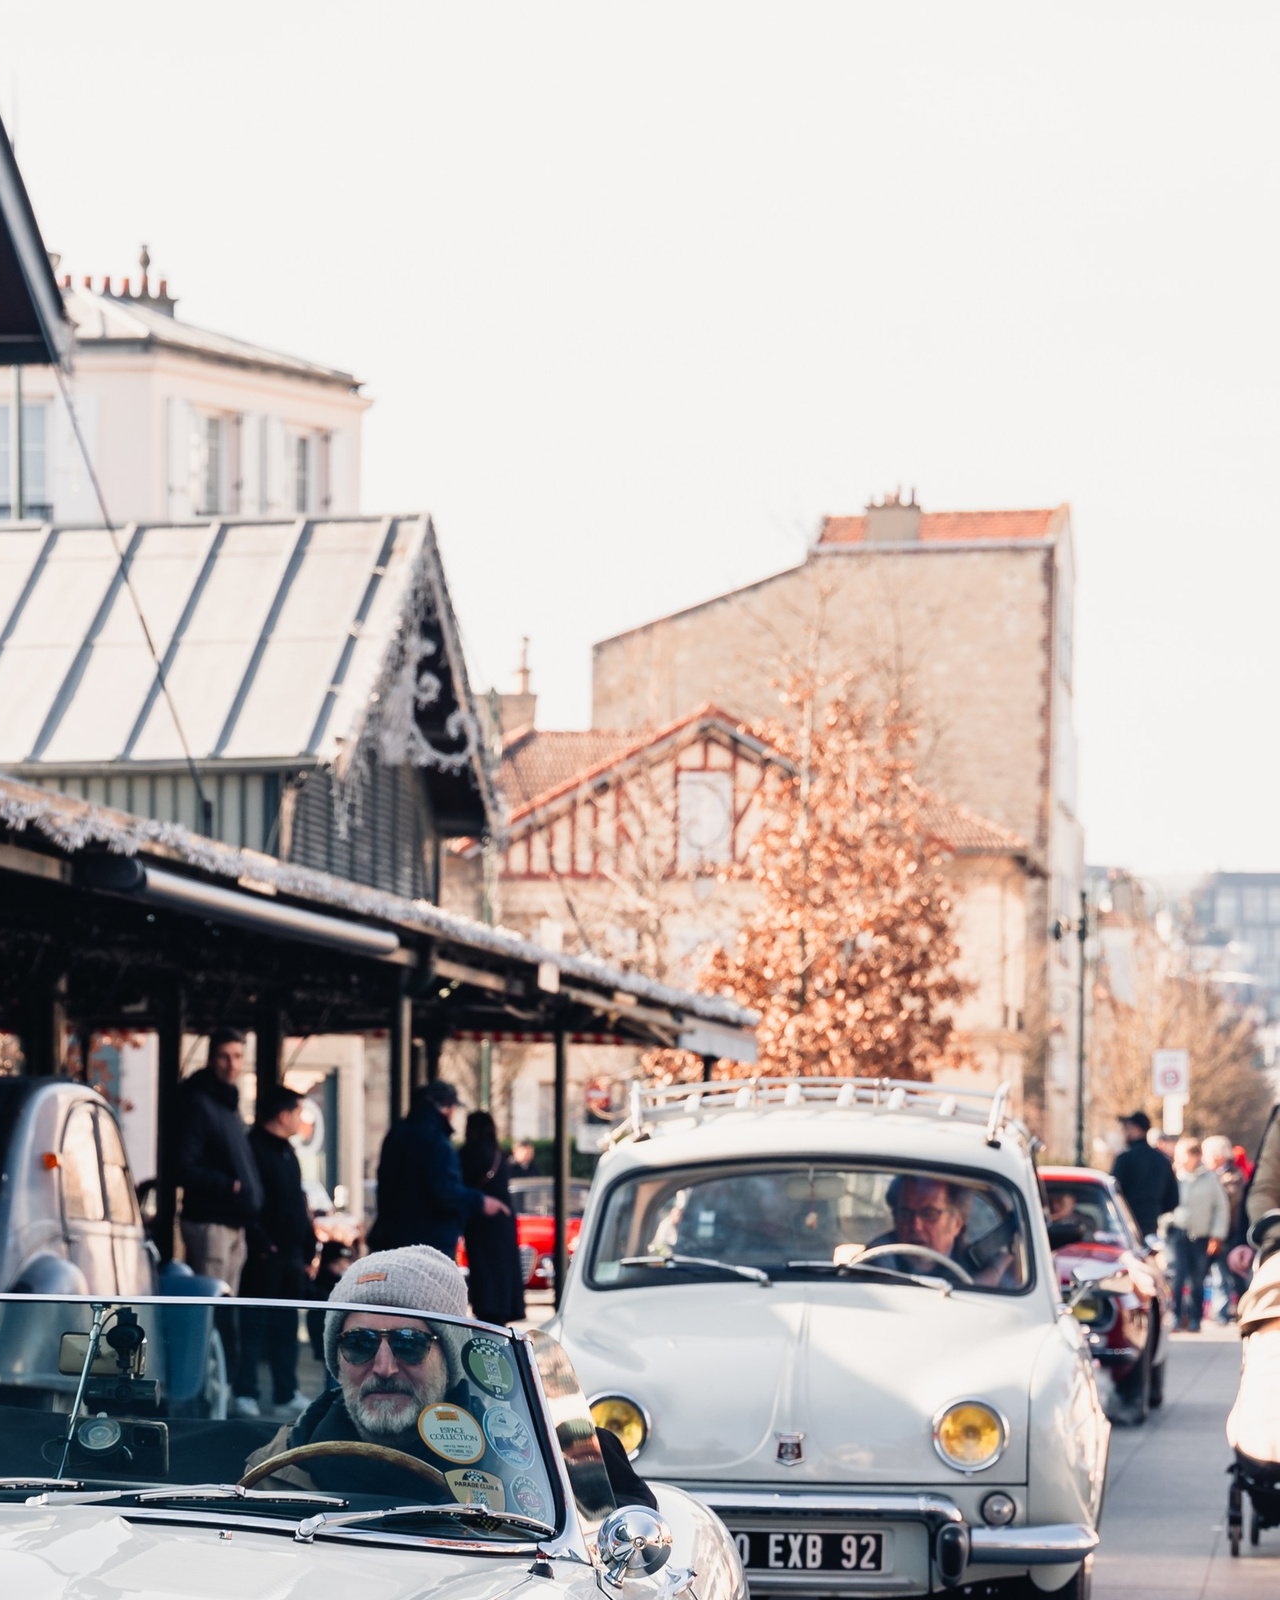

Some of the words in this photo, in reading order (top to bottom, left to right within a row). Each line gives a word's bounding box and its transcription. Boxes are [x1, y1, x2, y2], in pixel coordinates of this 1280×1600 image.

[429, 1433, 478, 1442] COLLECTION
[454, 1480, 479, 1489] PARADE
[479, 1483, 495, 1491] CLUB
[735, 1533, 750, 1566] 0
[769, 1534, 822, 1568] EXB
[841, 1535, 877, 1570] 92
